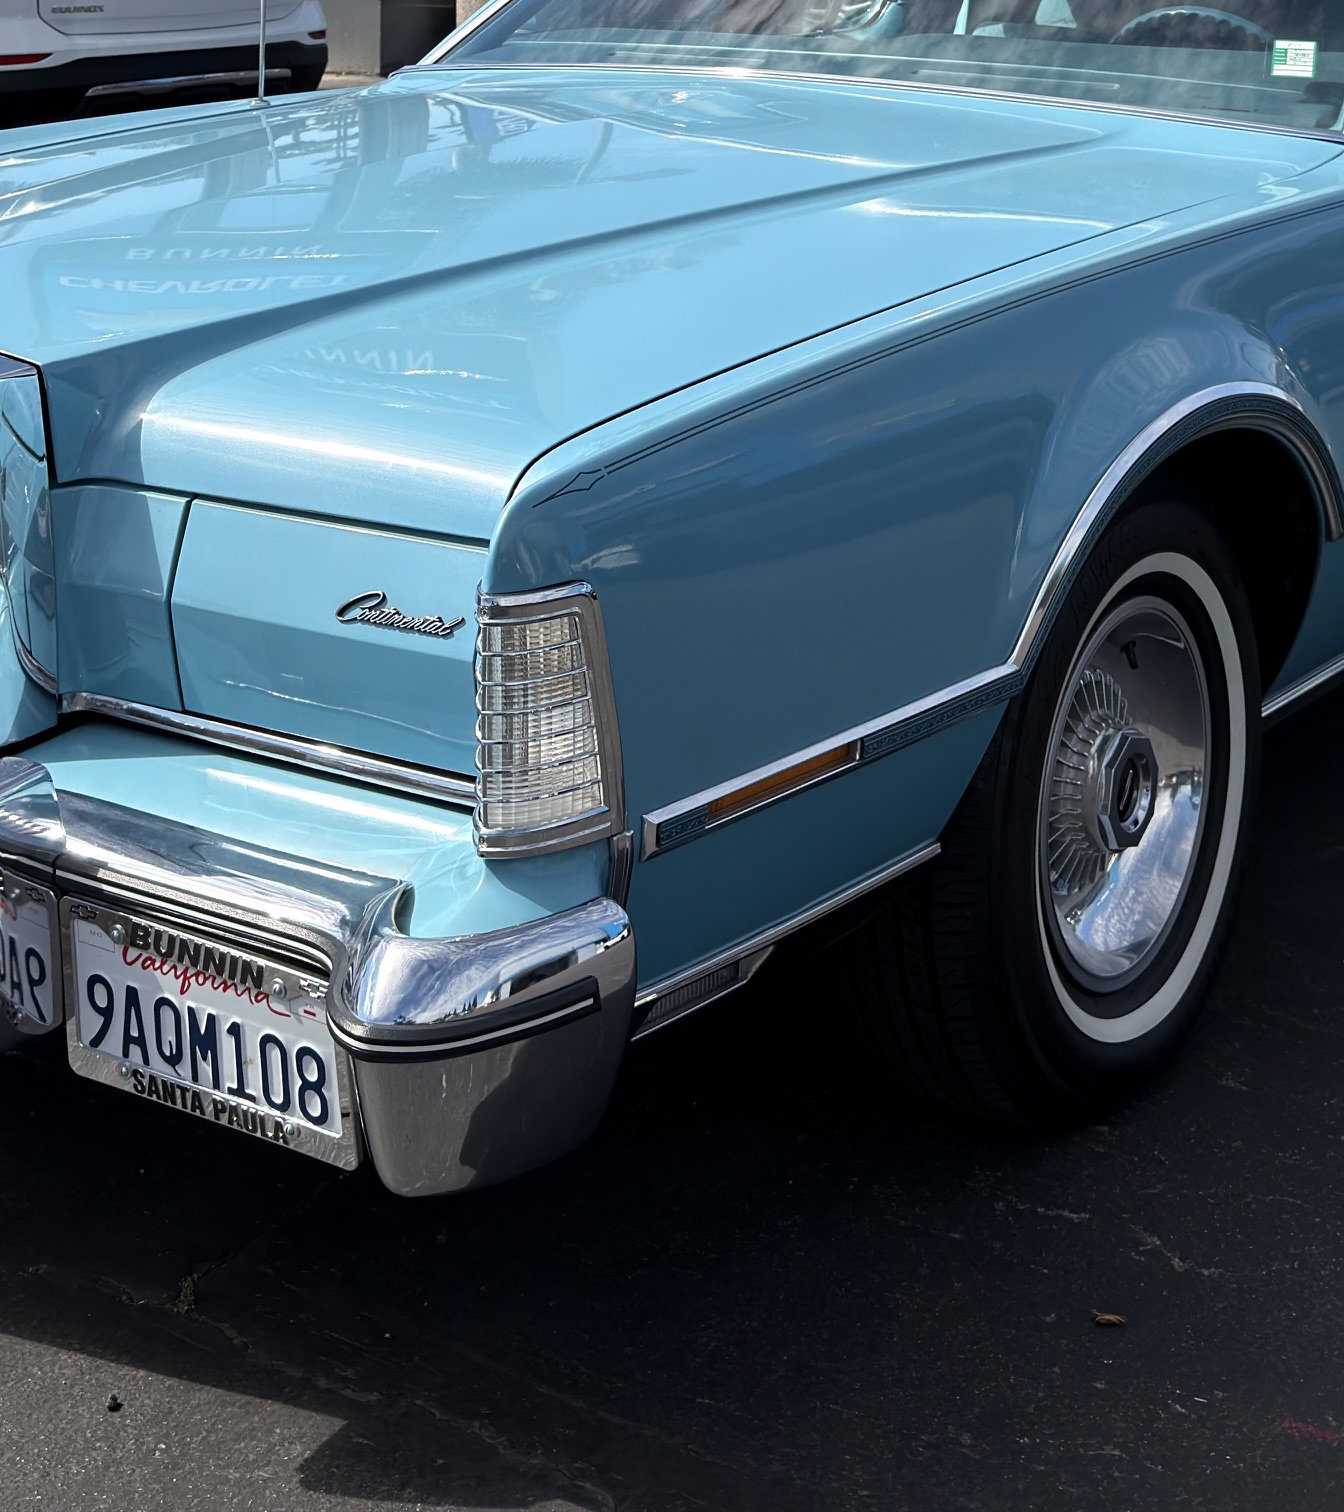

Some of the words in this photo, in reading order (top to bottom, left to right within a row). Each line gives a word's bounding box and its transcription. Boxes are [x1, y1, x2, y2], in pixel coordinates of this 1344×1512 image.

[335, 590, 467, 638] Continental
[122, 944, 291, 1017] California
[129, 918, 265, 991] BUNNIN
[85, 973, 330, 1127] 9AQM108
[132, 1068, 206, 1116] SANTA
[212, 1095, 290, 1146] PAULA
